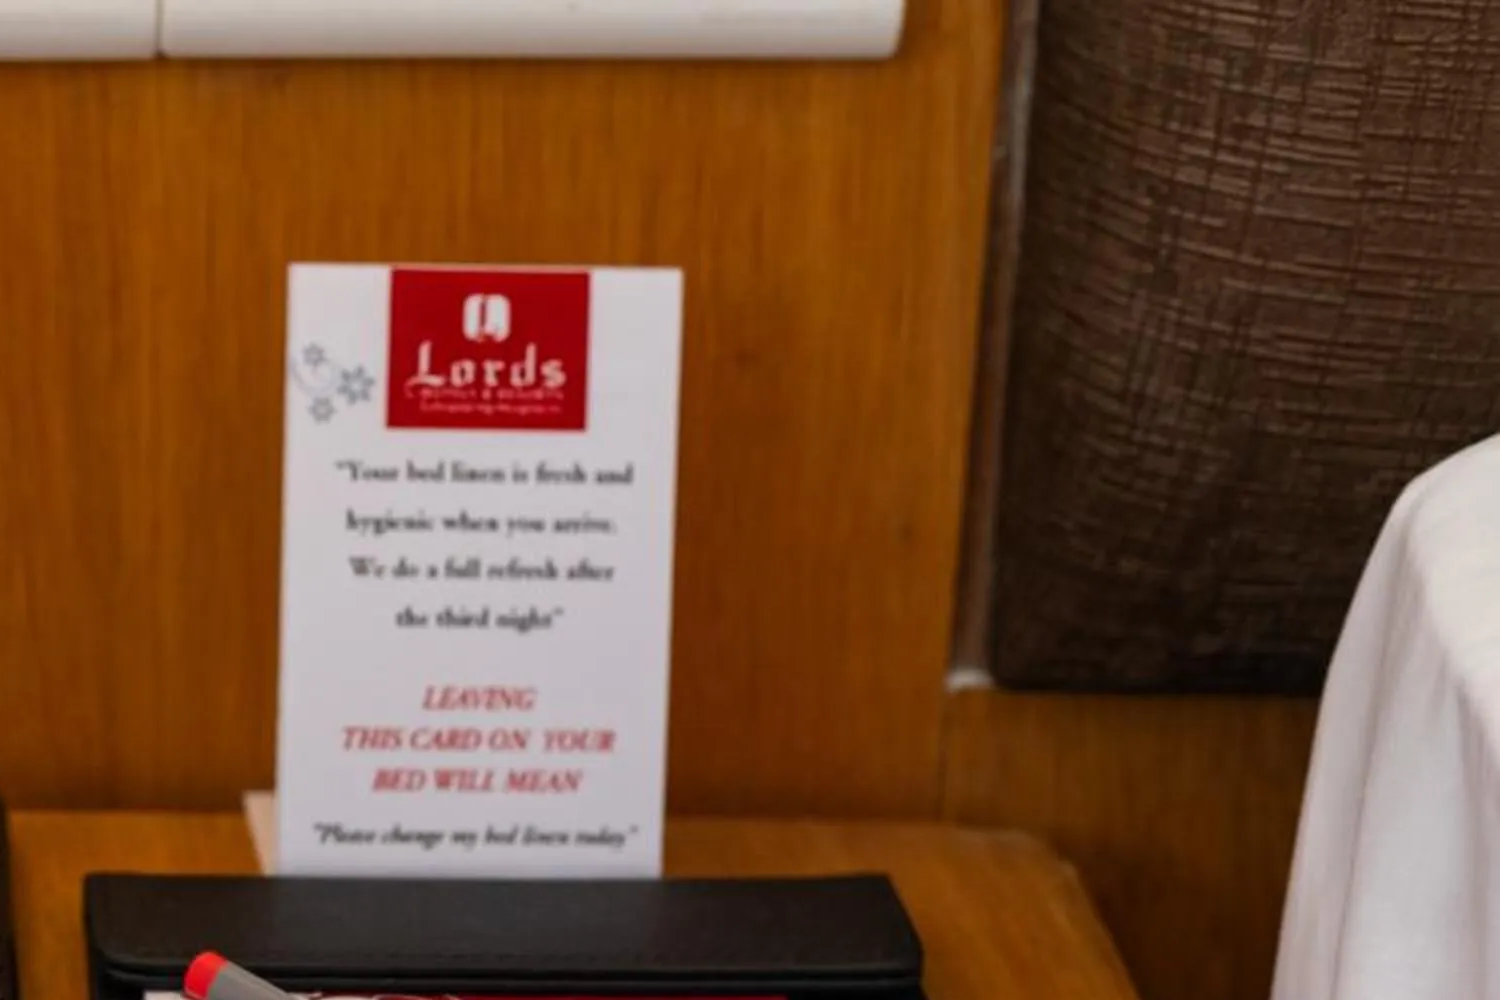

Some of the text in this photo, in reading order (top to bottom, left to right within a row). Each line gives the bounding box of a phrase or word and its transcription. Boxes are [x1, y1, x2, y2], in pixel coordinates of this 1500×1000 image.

[404, 341, 567, 390] Lords
[406, 459, 445, 482] bed
[512, 461, 528, 482] is
[535, 459, 586, 483] fresh
[595, 462, 634, 484] and
[346, 507, 433, 535] hygienic
[442, 509, 498, 531] when
[506, 514, 546, 538] you
[348, 556, 615, 580] We do a full refresh after
[395, 604, 429, 627] the
[435, 605, 490, 628] third
[421, 685, 538, 711] LEAVING
[342, 725, 616, 753] THIS CARD ON YOUR
[371, 767, 583, 793] BED WILL MEAN
[381, 823, 445, 850] change
[452, 832, 478, 851] my
[485, 824, 520, 845] bed
